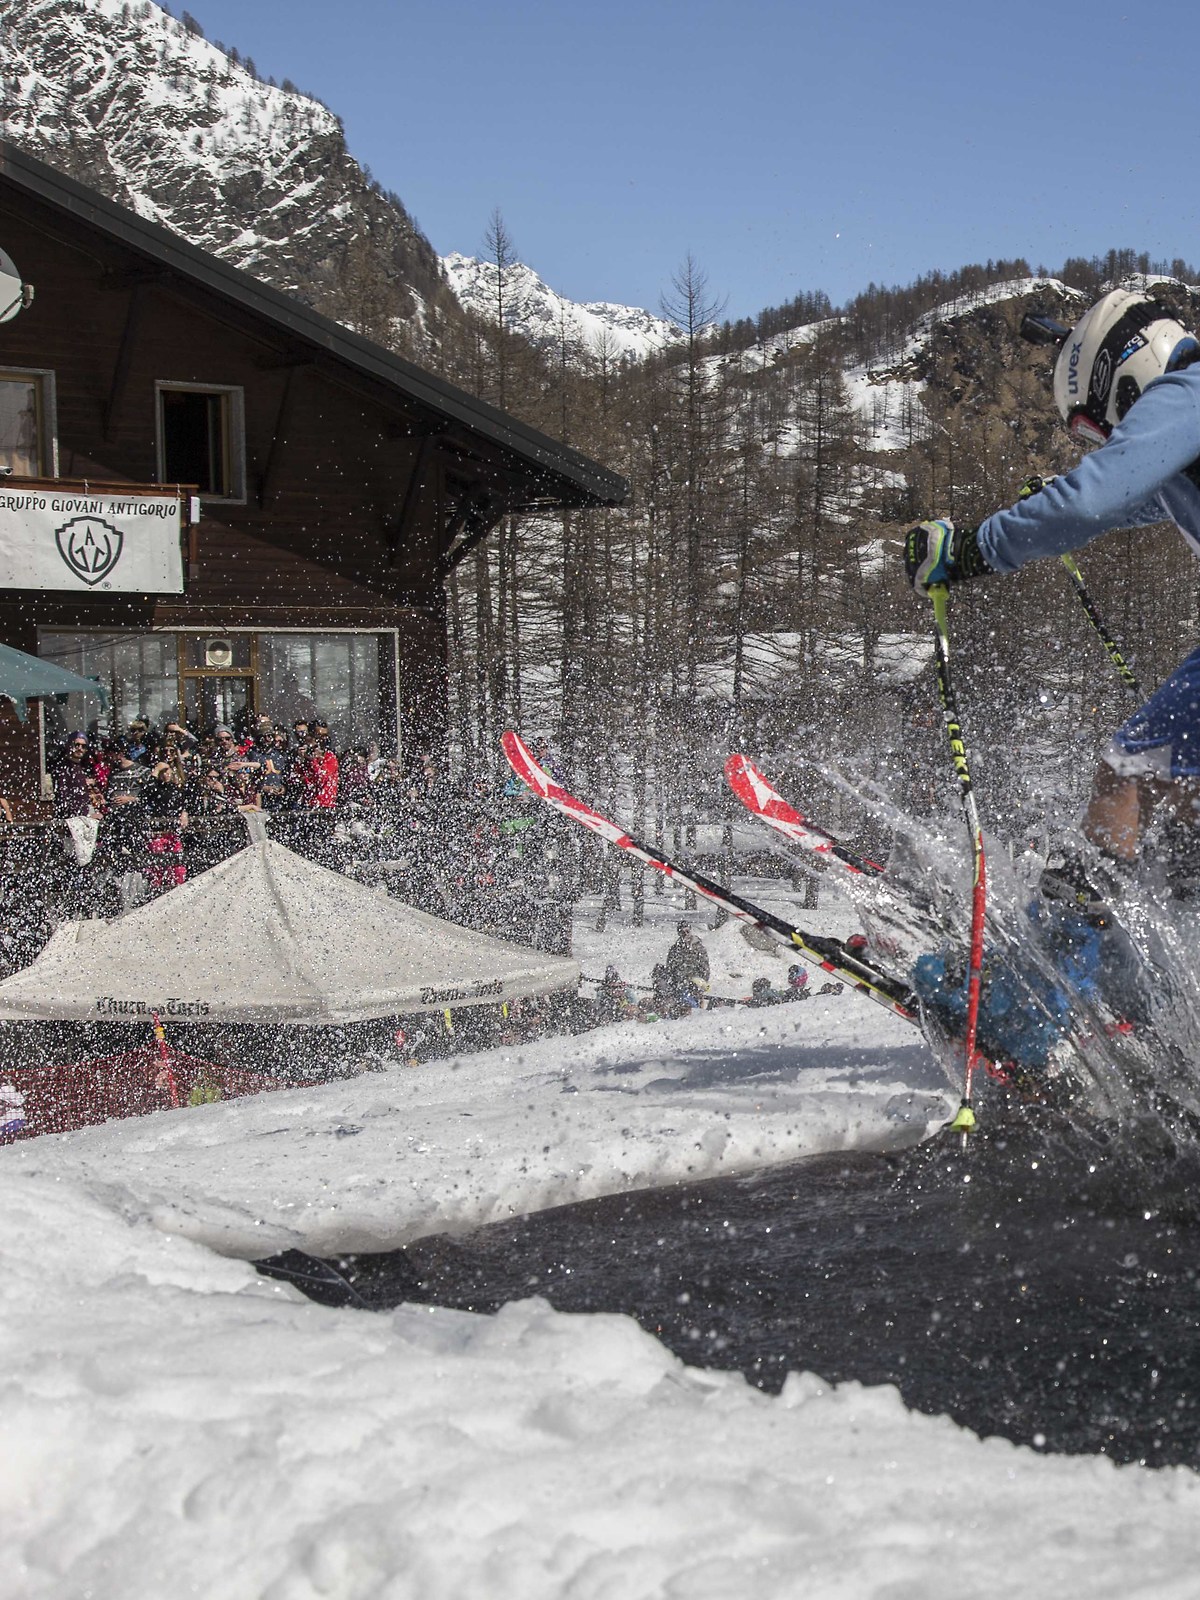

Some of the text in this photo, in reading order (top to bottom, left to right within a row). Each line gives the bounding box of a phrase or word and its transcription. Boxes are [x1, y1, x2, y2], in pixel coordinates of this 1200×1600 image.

[1068, 341, 1083, 395] uvex
[0, 496, 177, 519] GRUPPO GIOVANI ANTIGORIO
